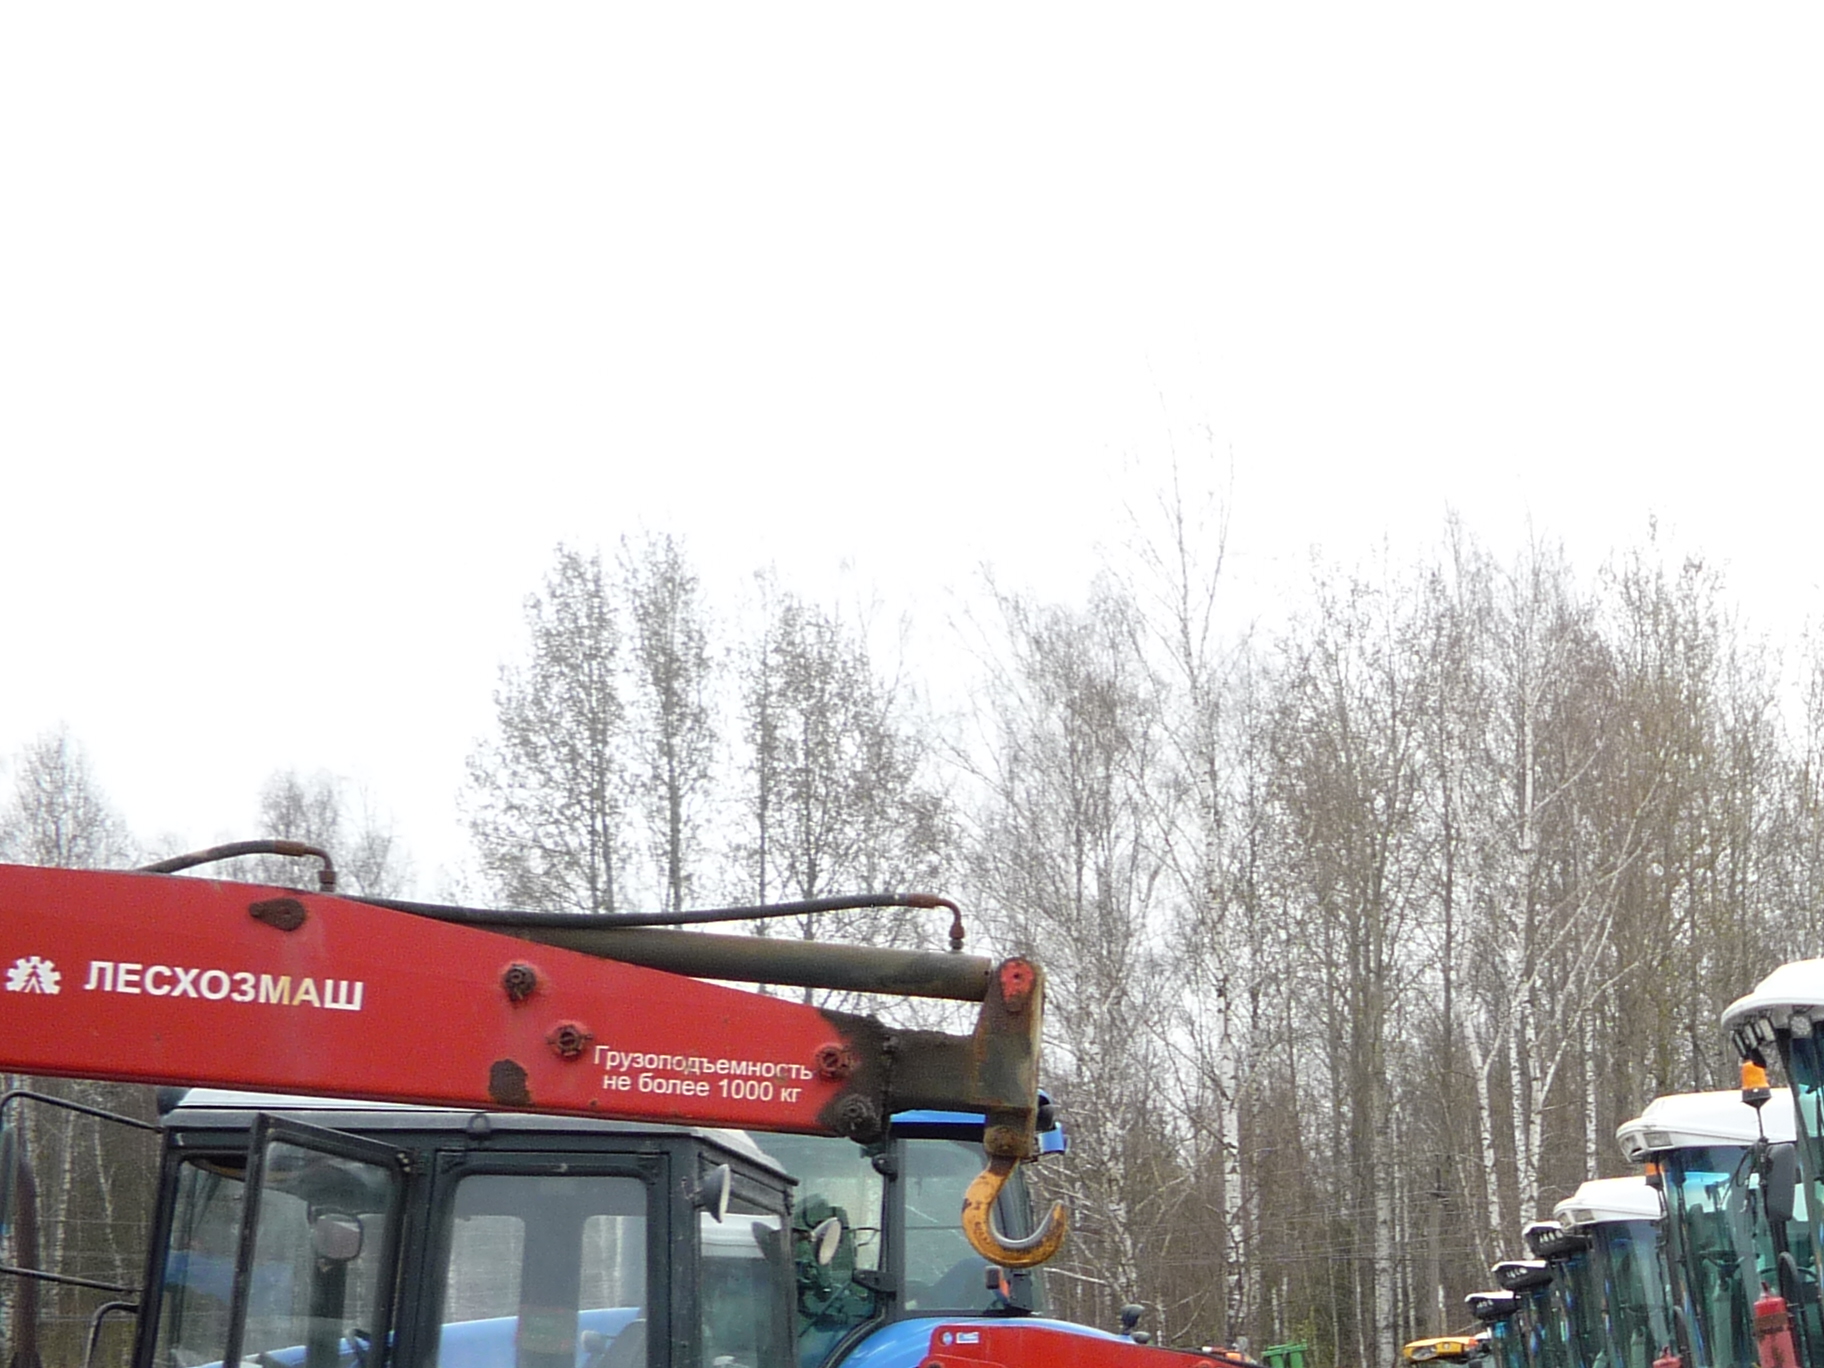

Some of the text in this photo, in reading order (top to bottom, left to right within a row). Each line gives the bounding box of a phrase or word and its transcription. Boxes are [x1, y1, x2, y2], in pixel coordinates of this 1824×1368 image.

[83, 960, 364, 1011] ЛЕСХОЗМАШ
[593, 1045, 813, 1080] Грузоподъемность
[603, 1072, 802, 1103] не более 1000 кг
